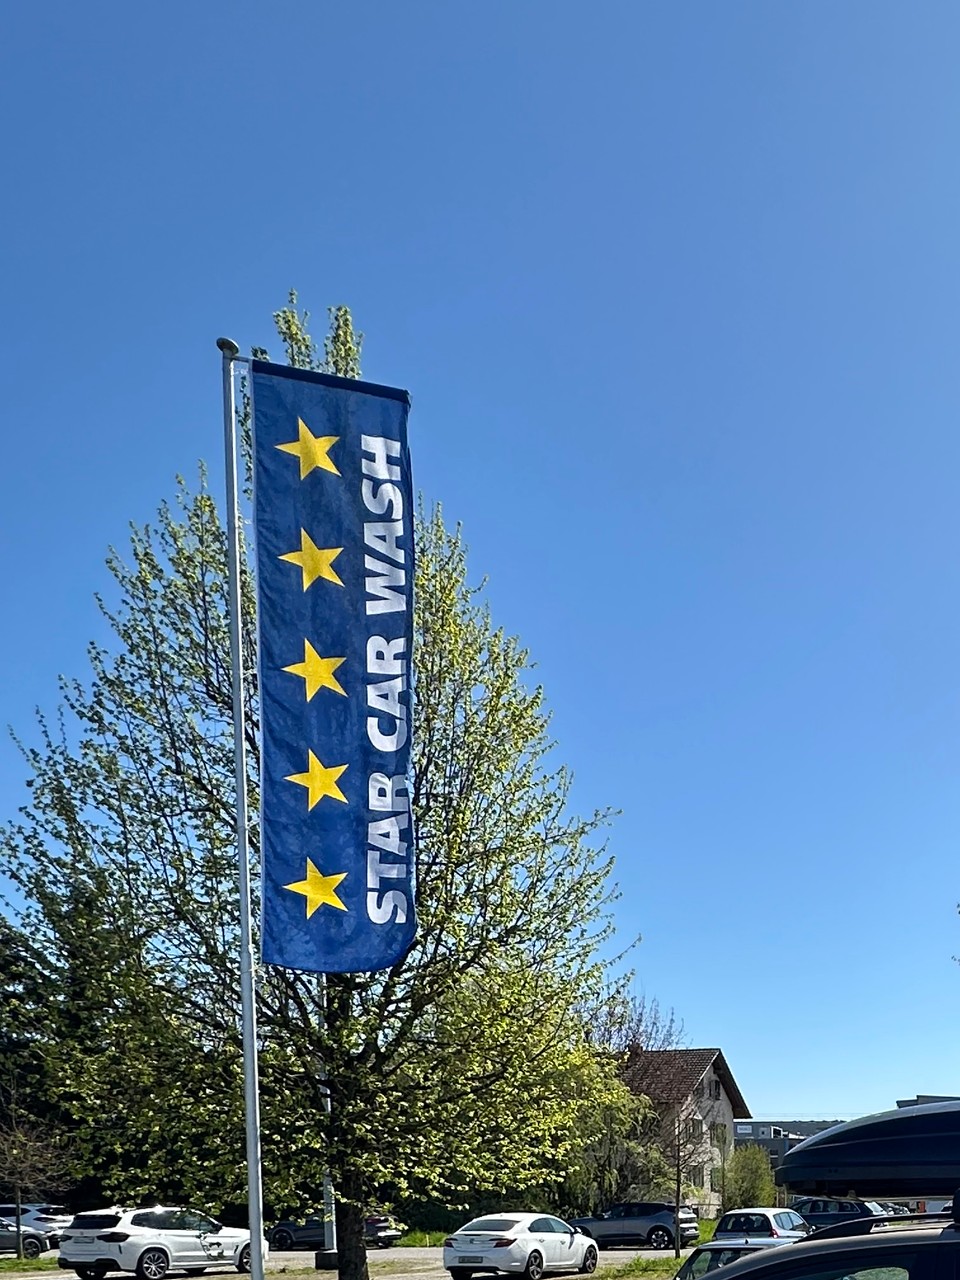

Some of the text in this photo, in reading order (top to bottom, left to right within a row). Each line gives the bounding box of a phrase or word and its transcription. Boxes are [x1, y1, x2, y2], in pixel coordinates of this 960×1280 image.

[361, 434, 408, 925] STAR CAR WASH
